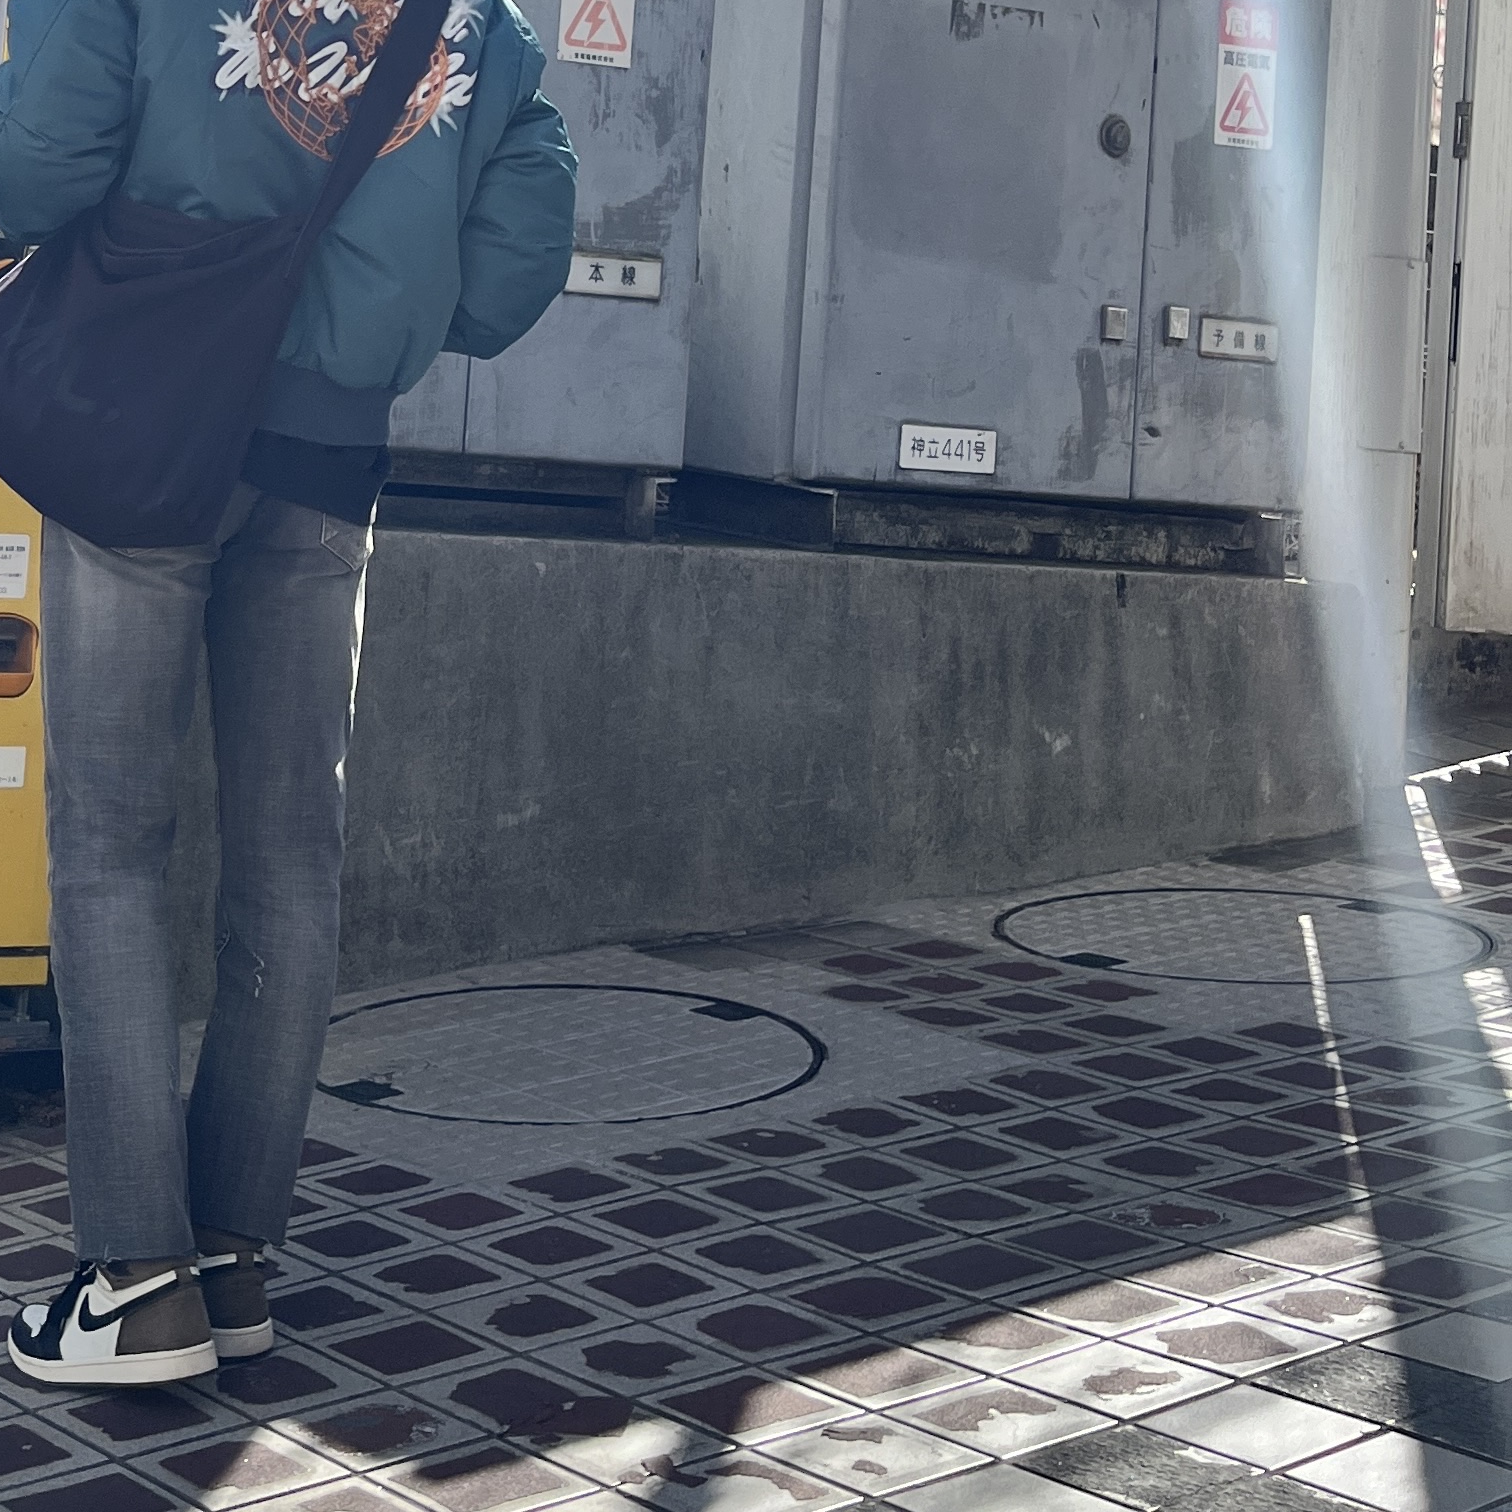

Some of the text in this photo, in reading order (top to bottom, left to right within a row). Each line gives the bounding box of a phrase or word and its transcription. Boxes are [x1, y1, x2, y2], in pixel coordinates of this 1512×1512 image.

[1224, 6, 1273, 41] 危険
[1223, 50, 1271, 71] 高圧電気
[588, 262, 637, 287] 本線
[1212, 329, 1266, 352] 予備線
[910, 435, 987, 463] 神立441号
